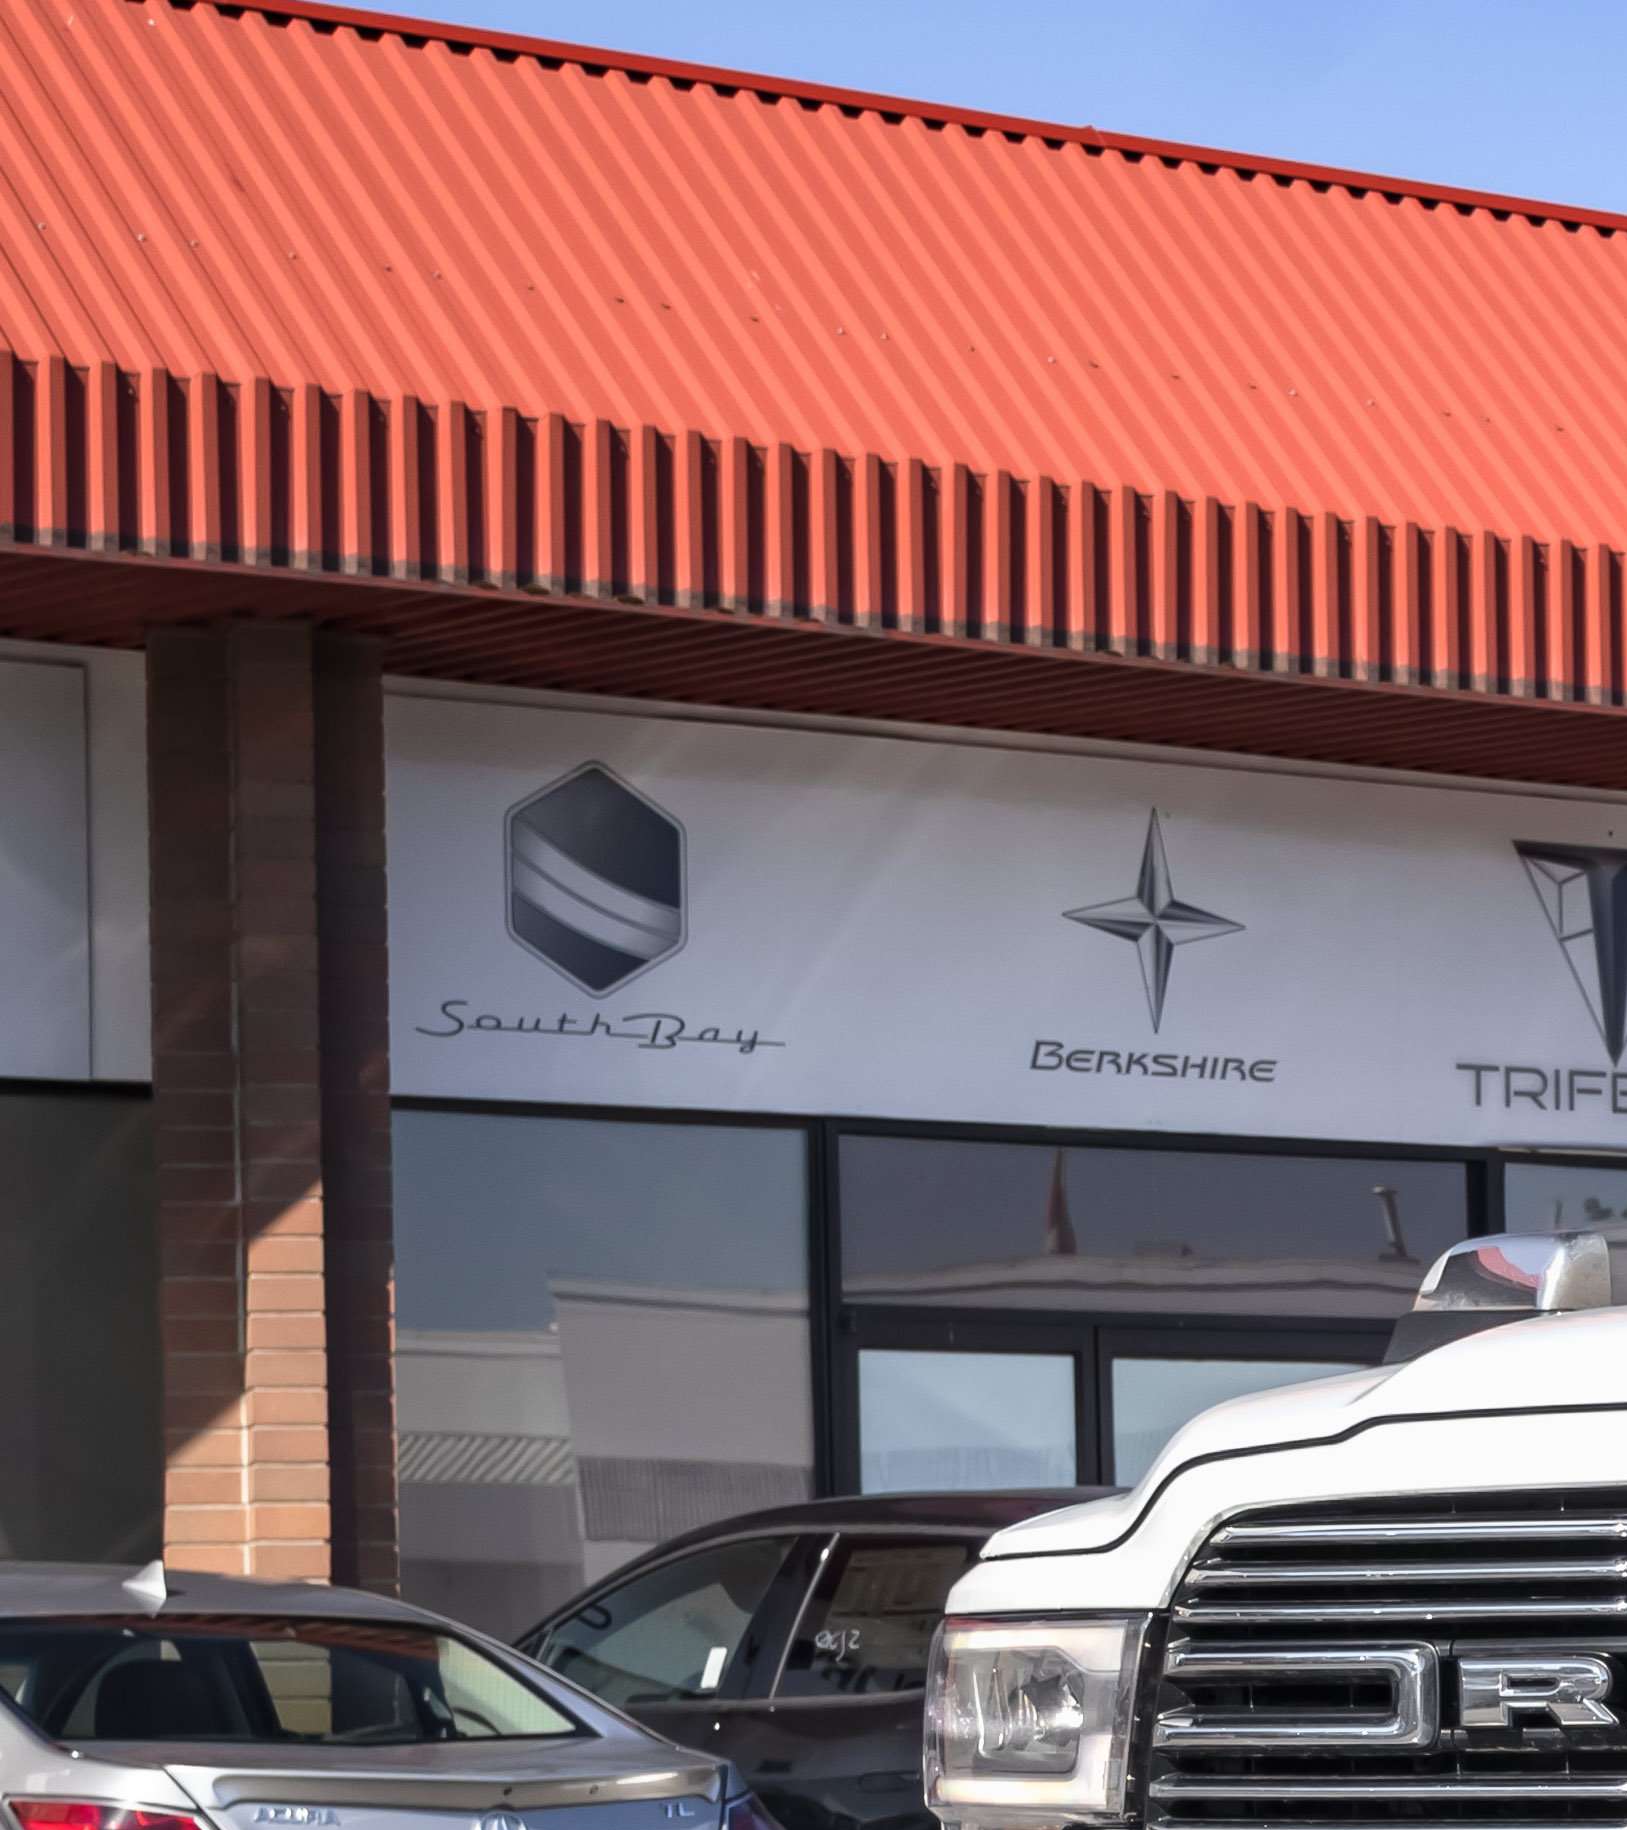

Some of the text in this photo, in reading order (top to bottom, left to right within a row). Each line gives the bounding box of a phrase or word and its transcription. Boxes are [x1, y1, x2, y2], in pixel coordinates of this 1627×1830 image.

[414, 1000, 786, 1054] South Bay
[1029, 1039, 1279, 1083] BERKSHIRE
[660, 1800, 696, 1819] TL
